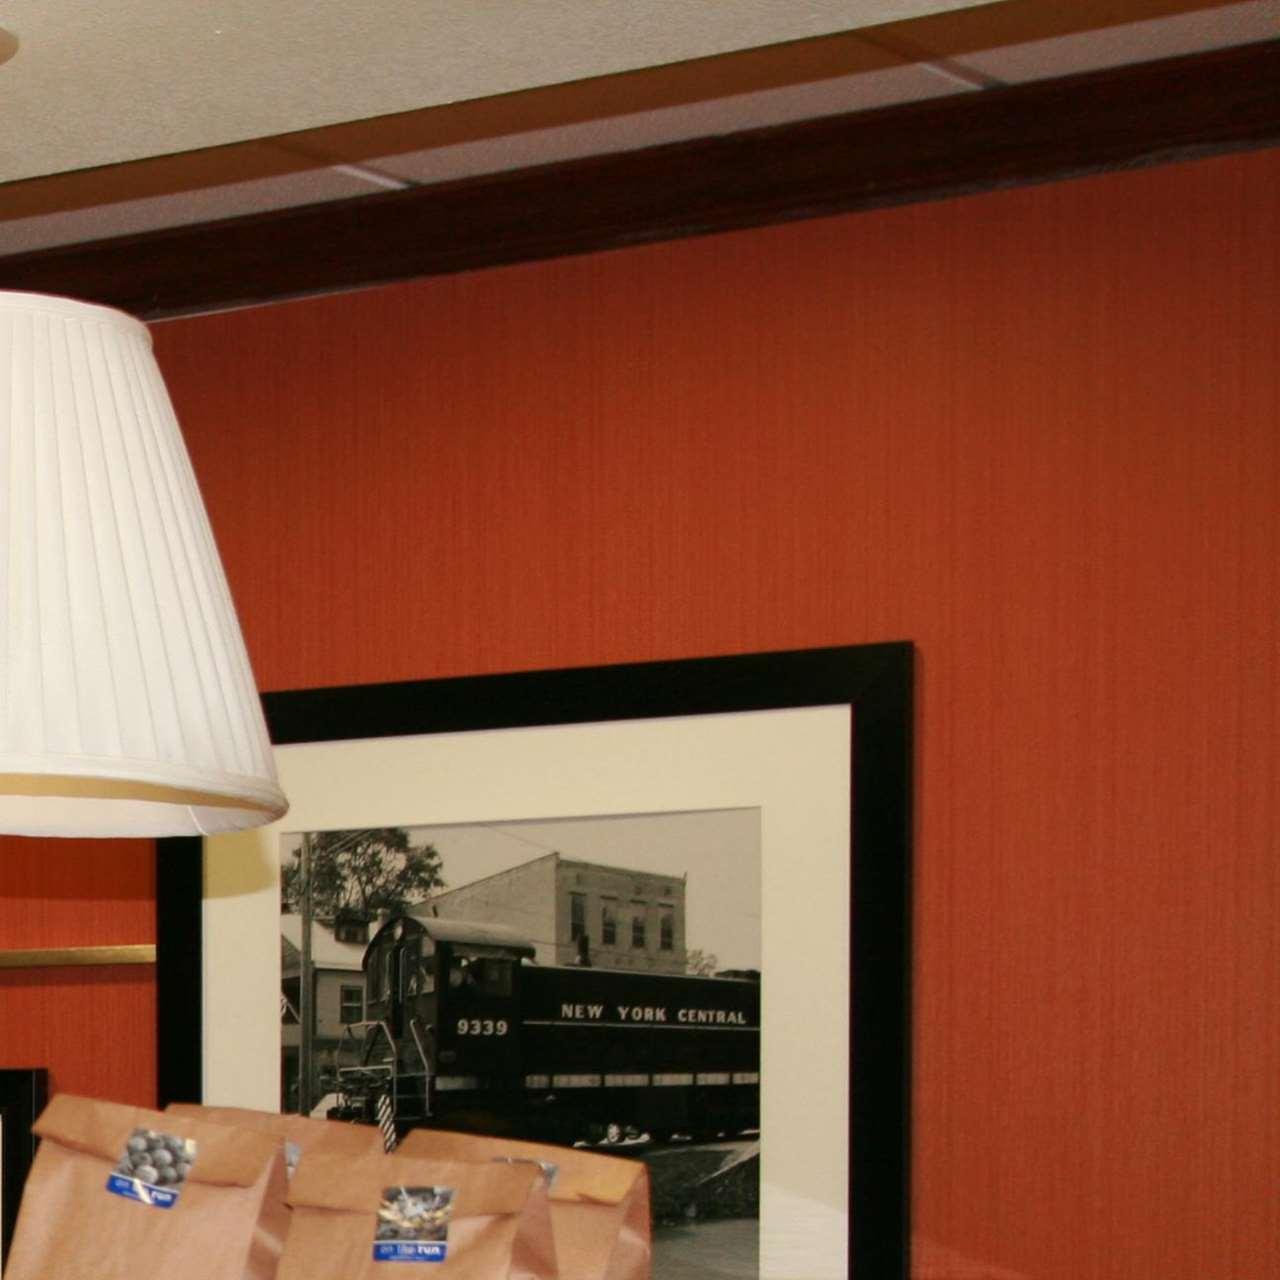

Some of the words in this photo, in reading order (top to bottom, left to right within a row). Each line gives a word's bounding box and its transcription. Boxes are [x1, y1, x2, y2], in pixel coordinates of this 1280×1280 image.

[561, 1003, 604, 1019] NEW
[618, 1006, 666, 1022] YORK
[677, 1009, 747, 1024] CENTRAL
[457, 1019, 508, 1036] 9339
[417, 1246, 440, 1255] run
